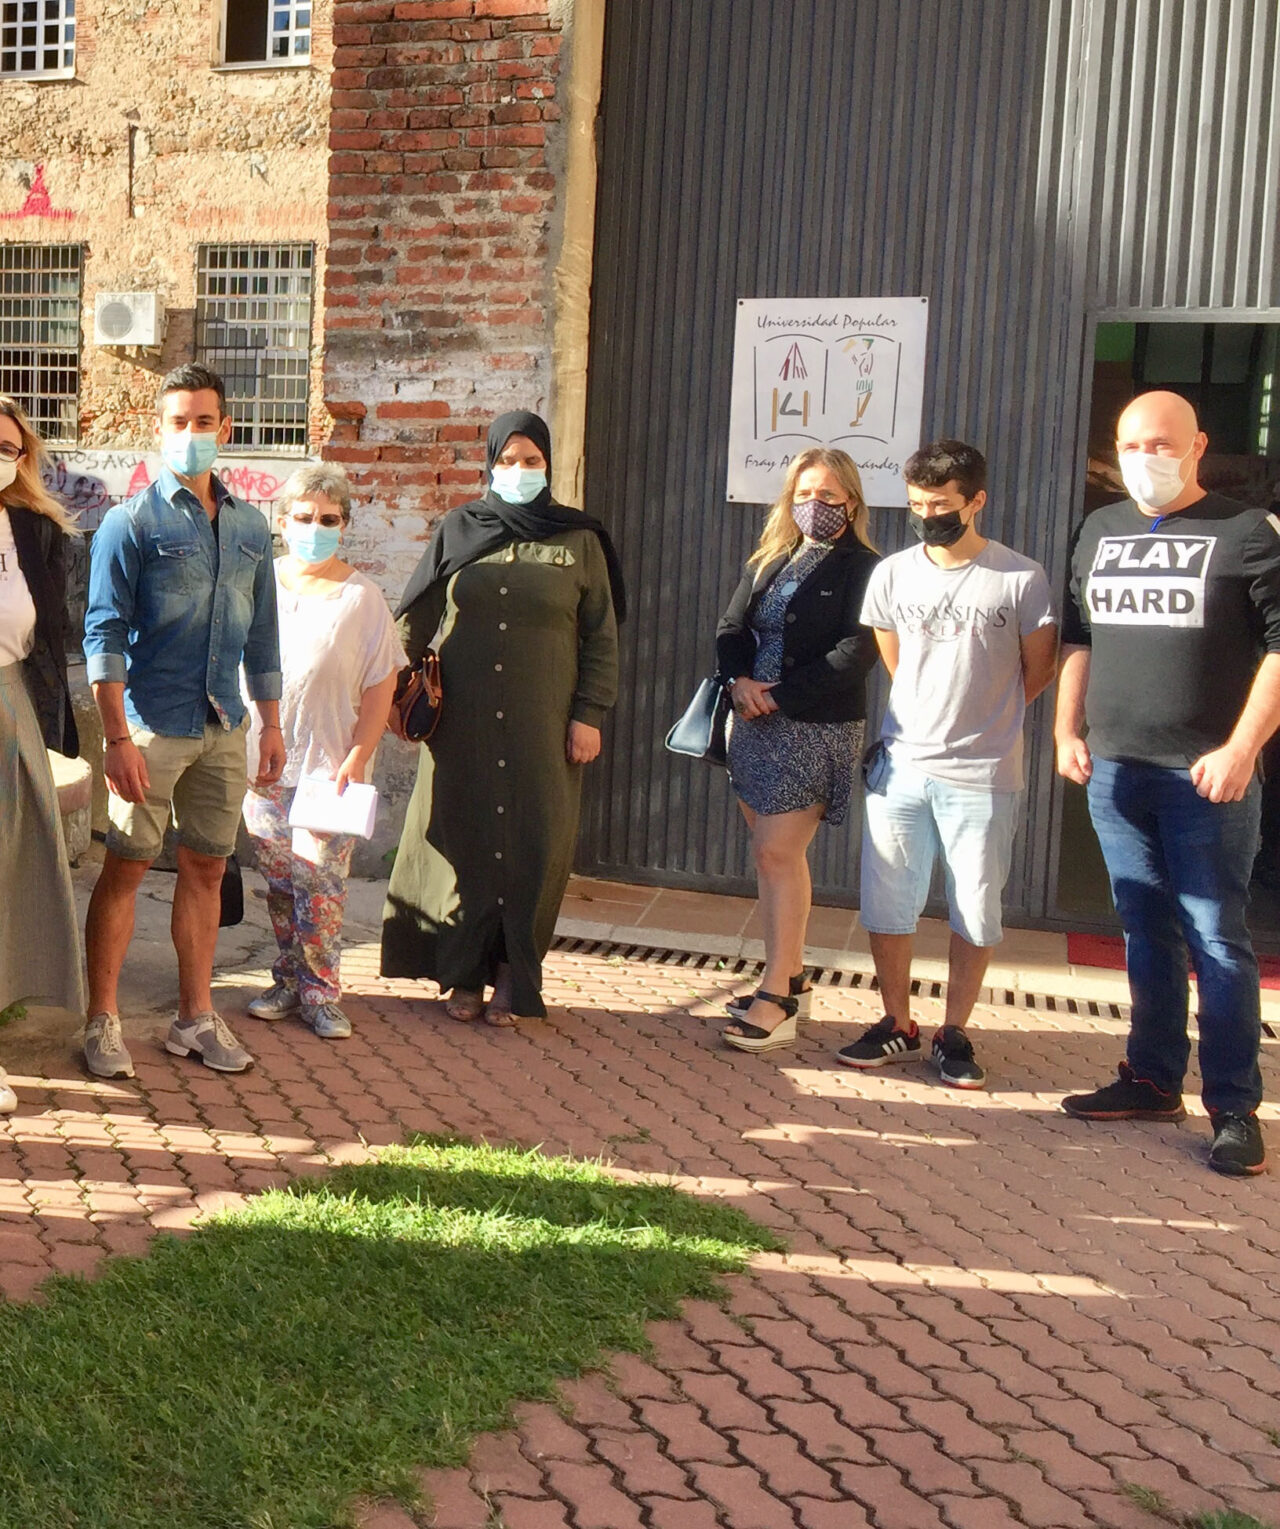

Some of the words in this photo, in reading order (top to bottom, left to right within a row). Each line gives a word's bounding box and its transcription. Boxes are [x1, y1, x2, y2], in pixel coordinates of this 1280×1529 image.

[757, 314, 838, 328] Universidad
[843, 314, 898, 331] Popular
[745, 454, 776, 473] Fray
[856, 456, 901, 476] nández
[1097, 541, 1206, 570] PLAY
[1091, 588, 1195, 614] HARD
